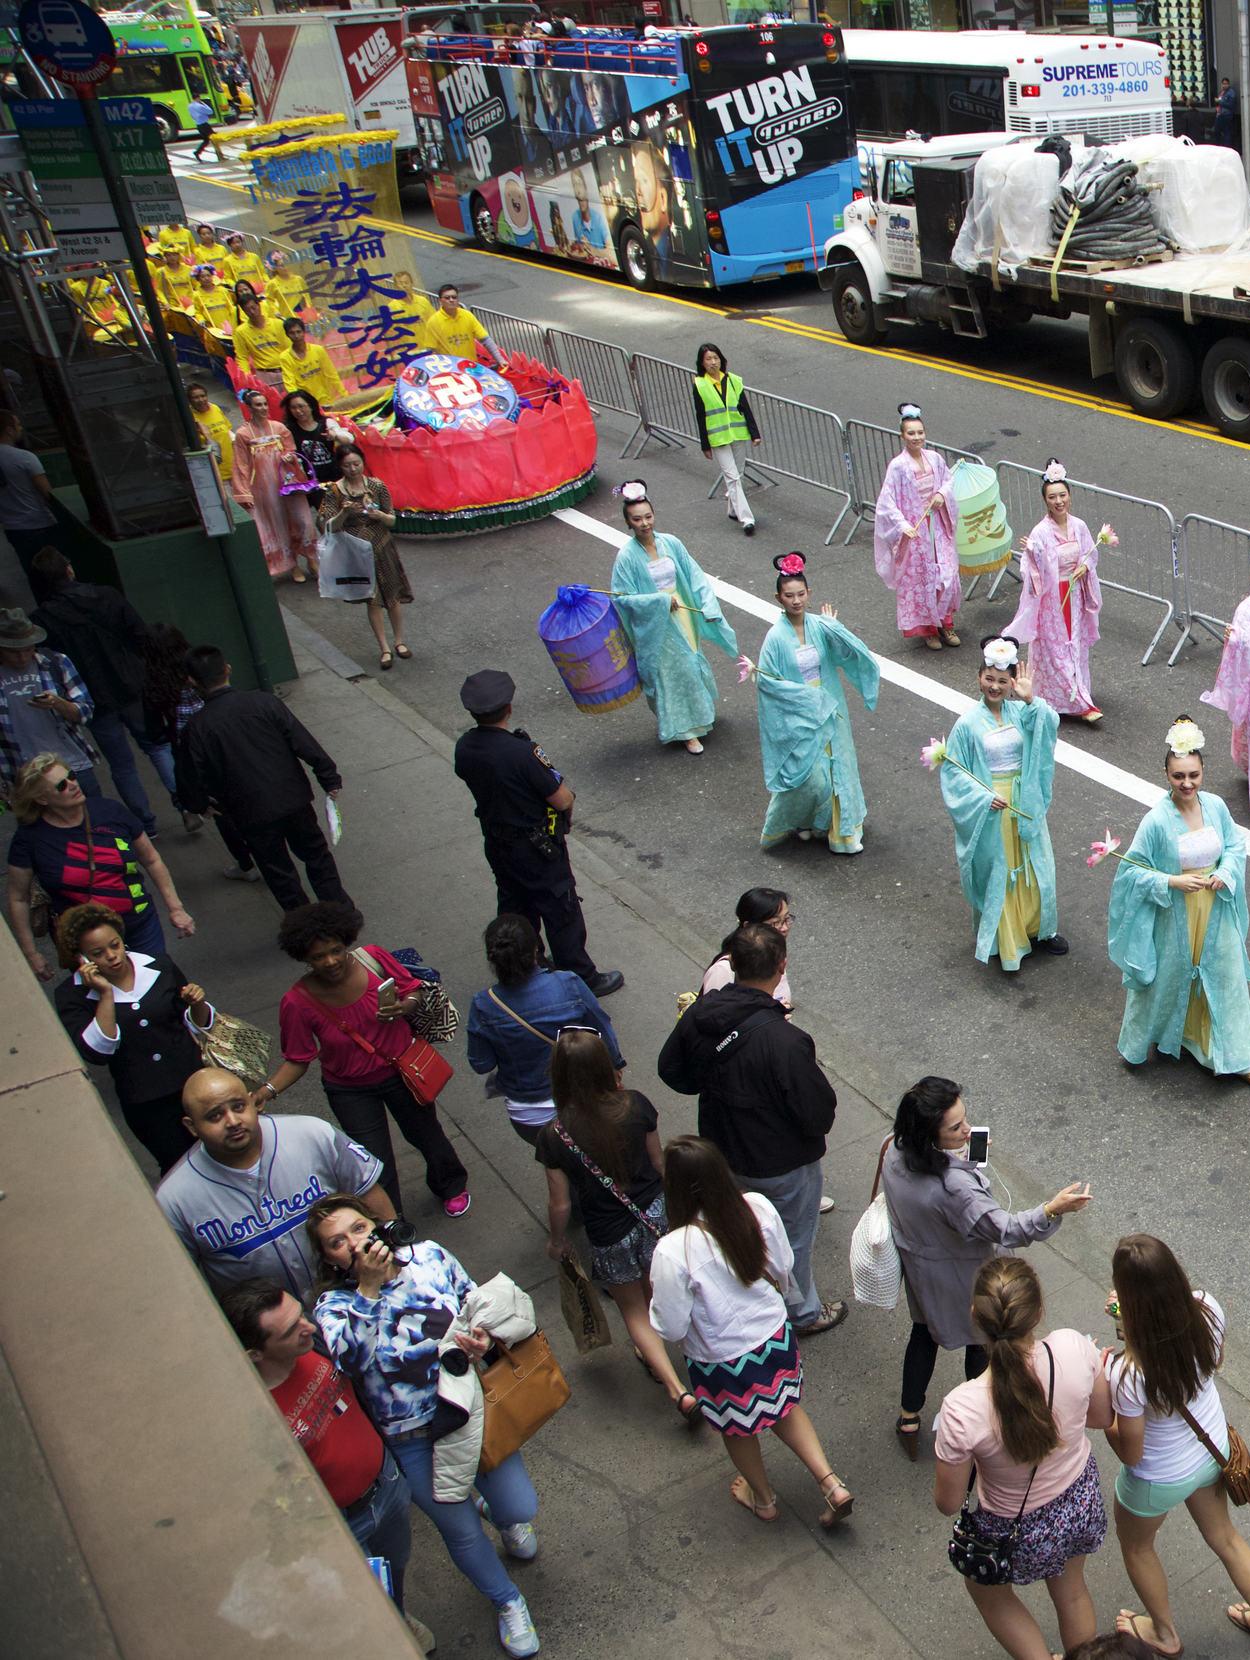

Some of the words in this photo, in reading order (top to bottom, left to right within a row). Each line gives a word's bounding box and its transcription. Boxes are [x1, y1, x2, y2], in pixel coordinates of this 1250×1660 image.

[760, 32, 774, 42] 106
[39, 58, 57, 76] NO
[61, 62, 111, 84] STANDING
[348, 27, 395, 84] HUB
[438, 58, 490, 119] TURN
[705, 64, 817, 134] TURN
[1062, 80, 1148, 97] 201-339-4860
[104, 102, 147, 121] M42
[466, 103, 502, 133] Turner
[759, 104, 837, 140] Turner
[338, 144, 355, 171] is
[358, 140, 393, 168] good
[448, 117, 470, 162] IT
[714, 127, 753, 175] IT
[466, 135, 492, 182] UP
[752, 137, 804, 185] UP
[59, 237, 80, 246] West
[71, 247, 99, 255] Avenue
[716, 1031, 739, 1052] Canon
[196, 1175, 328, 1249] Montreal
